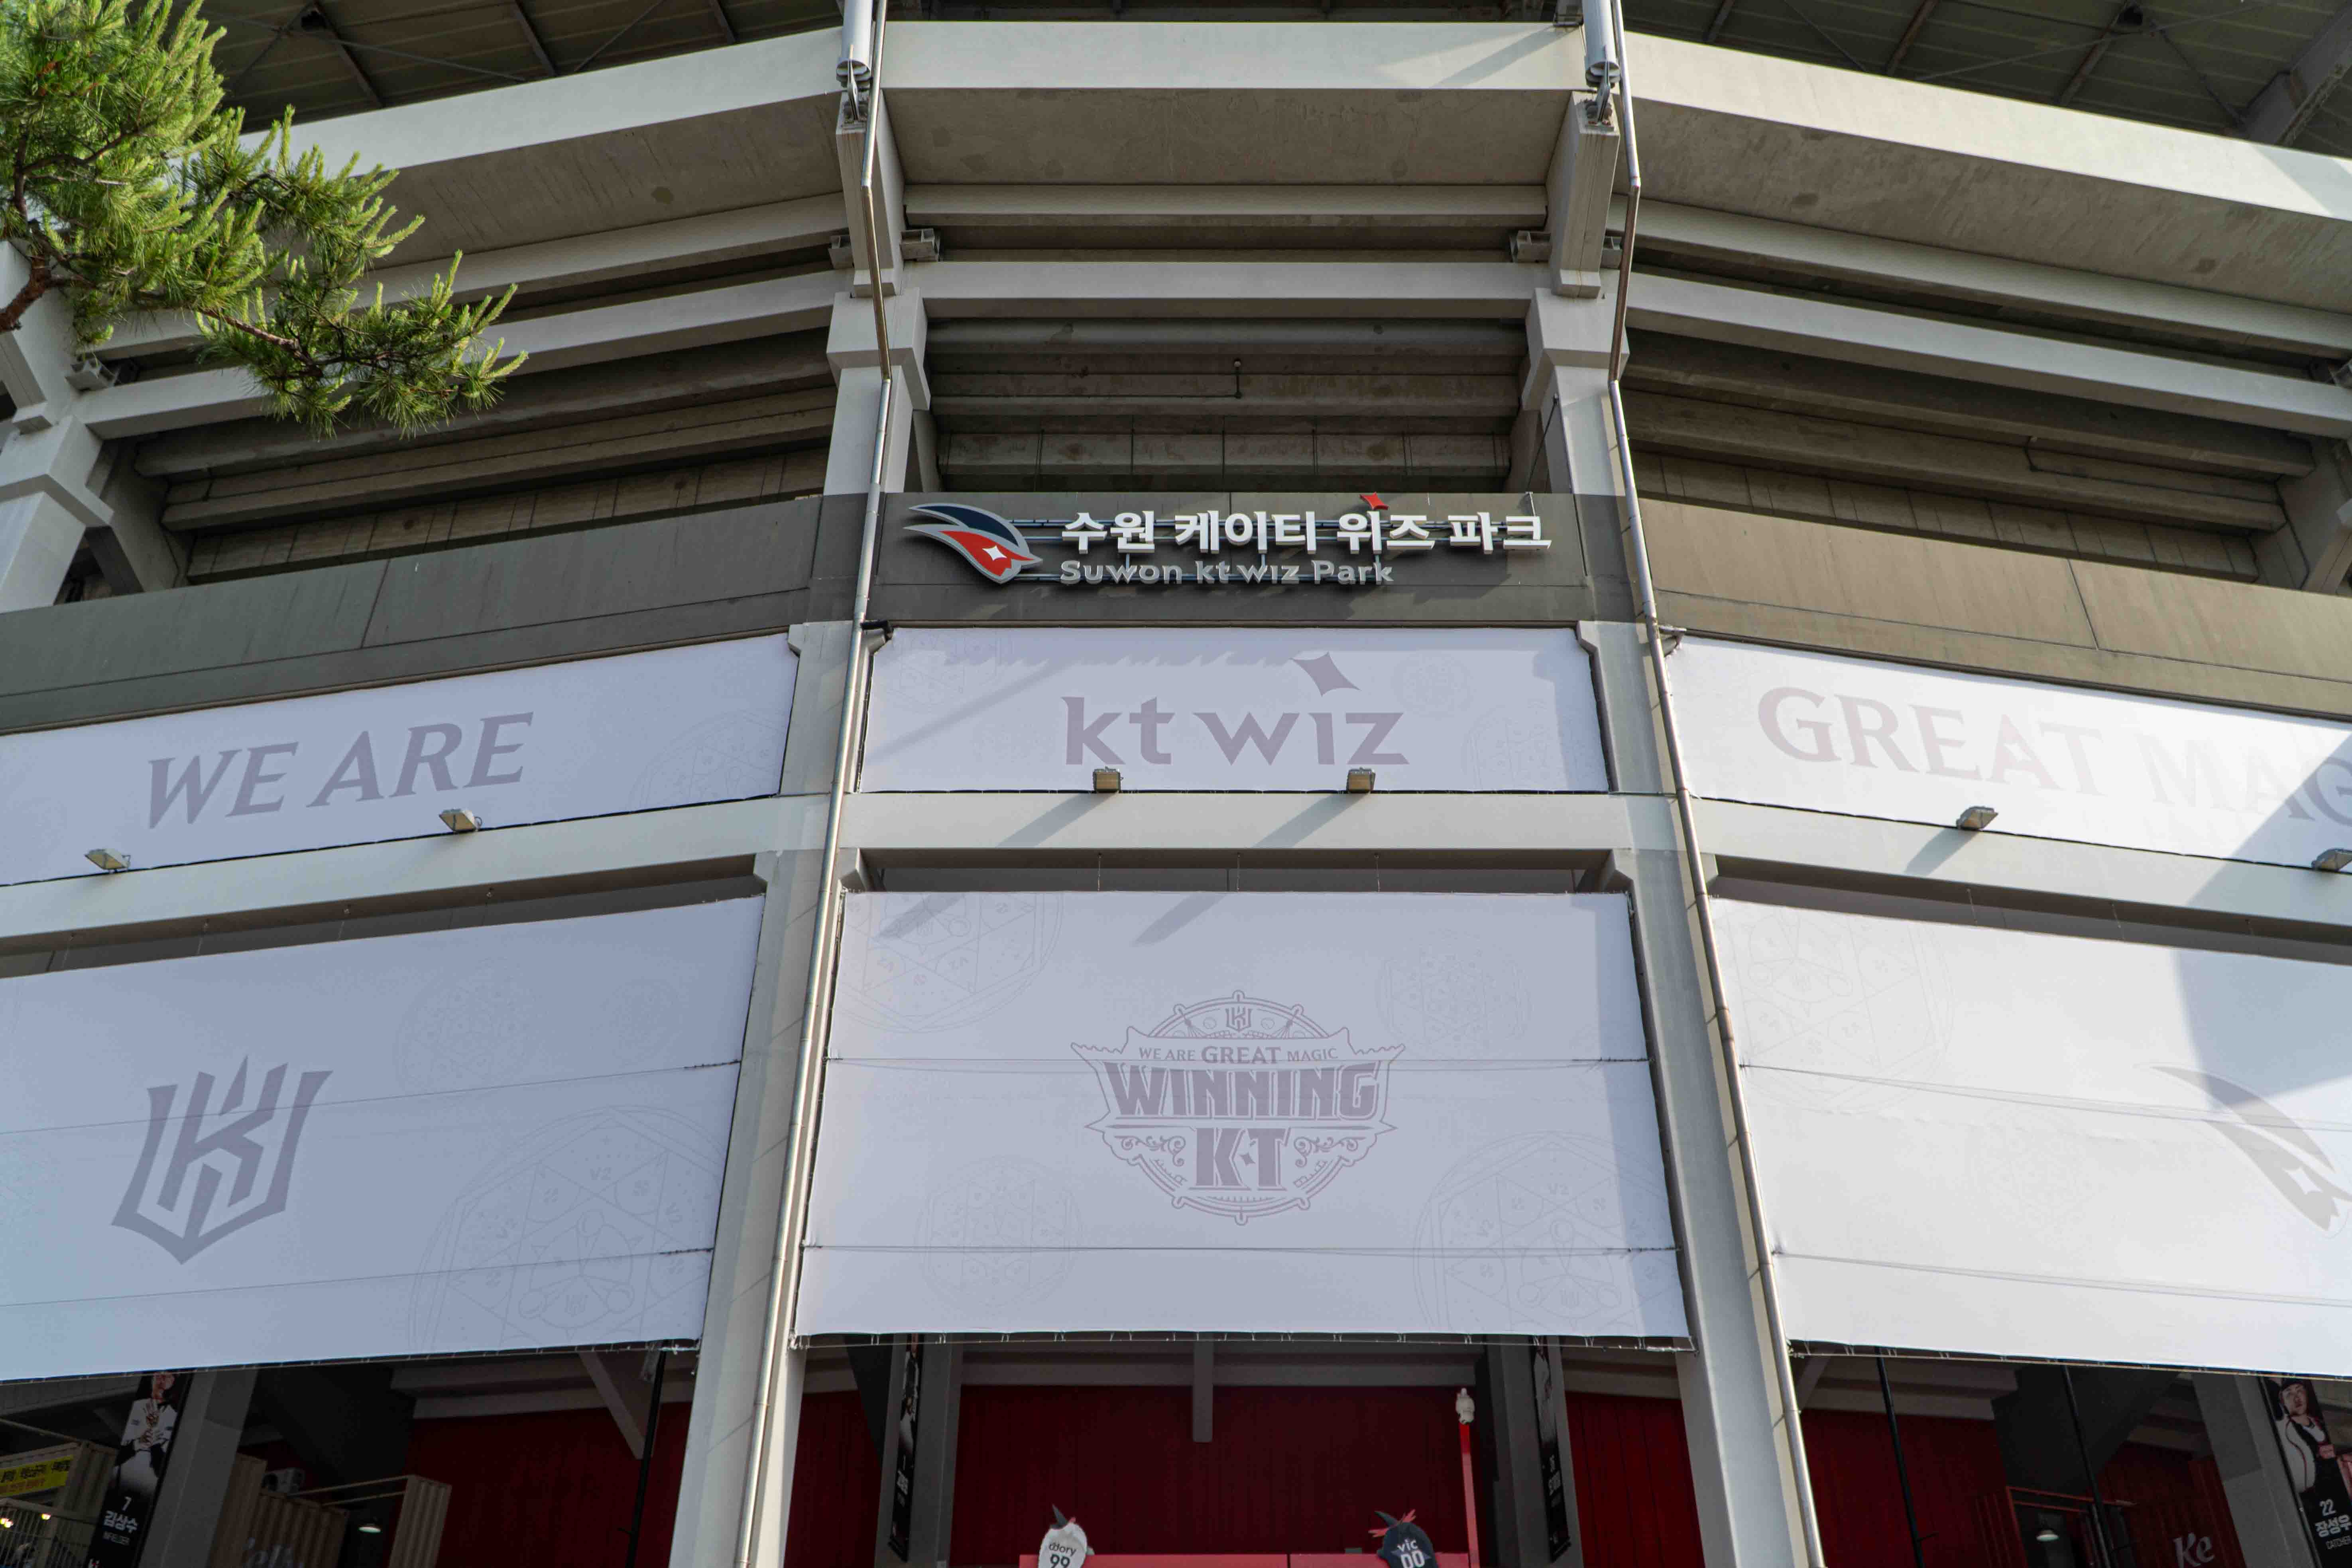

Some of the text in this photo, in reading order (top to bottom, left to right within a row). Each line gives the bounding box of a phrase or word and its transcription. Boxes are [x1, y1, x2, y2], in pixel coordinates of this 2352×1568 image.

[1062, 510, 1552, 555] 수원 케이티 위즈 파크
[1060, 560, 1394, 585] Suwon kt wiz Park
[1061, 696, 1176, 765] kt
[1757, 686, 2106, 797] GREAT
[149, 711, 534, 829] WE ARE
[1139, 1045, 1338, 1065] WE ARE GREAT MAGIC
[1103, 1061, 1382, 1119] WINNING
[1190, 1127, 1292, 1190] KT
[103, 1510, 138, 1533] 김상수
[2319, 1499, 2337, 1517] 22
[2315, 1515, 2352, 1538] 장성우
[1396, 1538, 1418, 1552] vic
